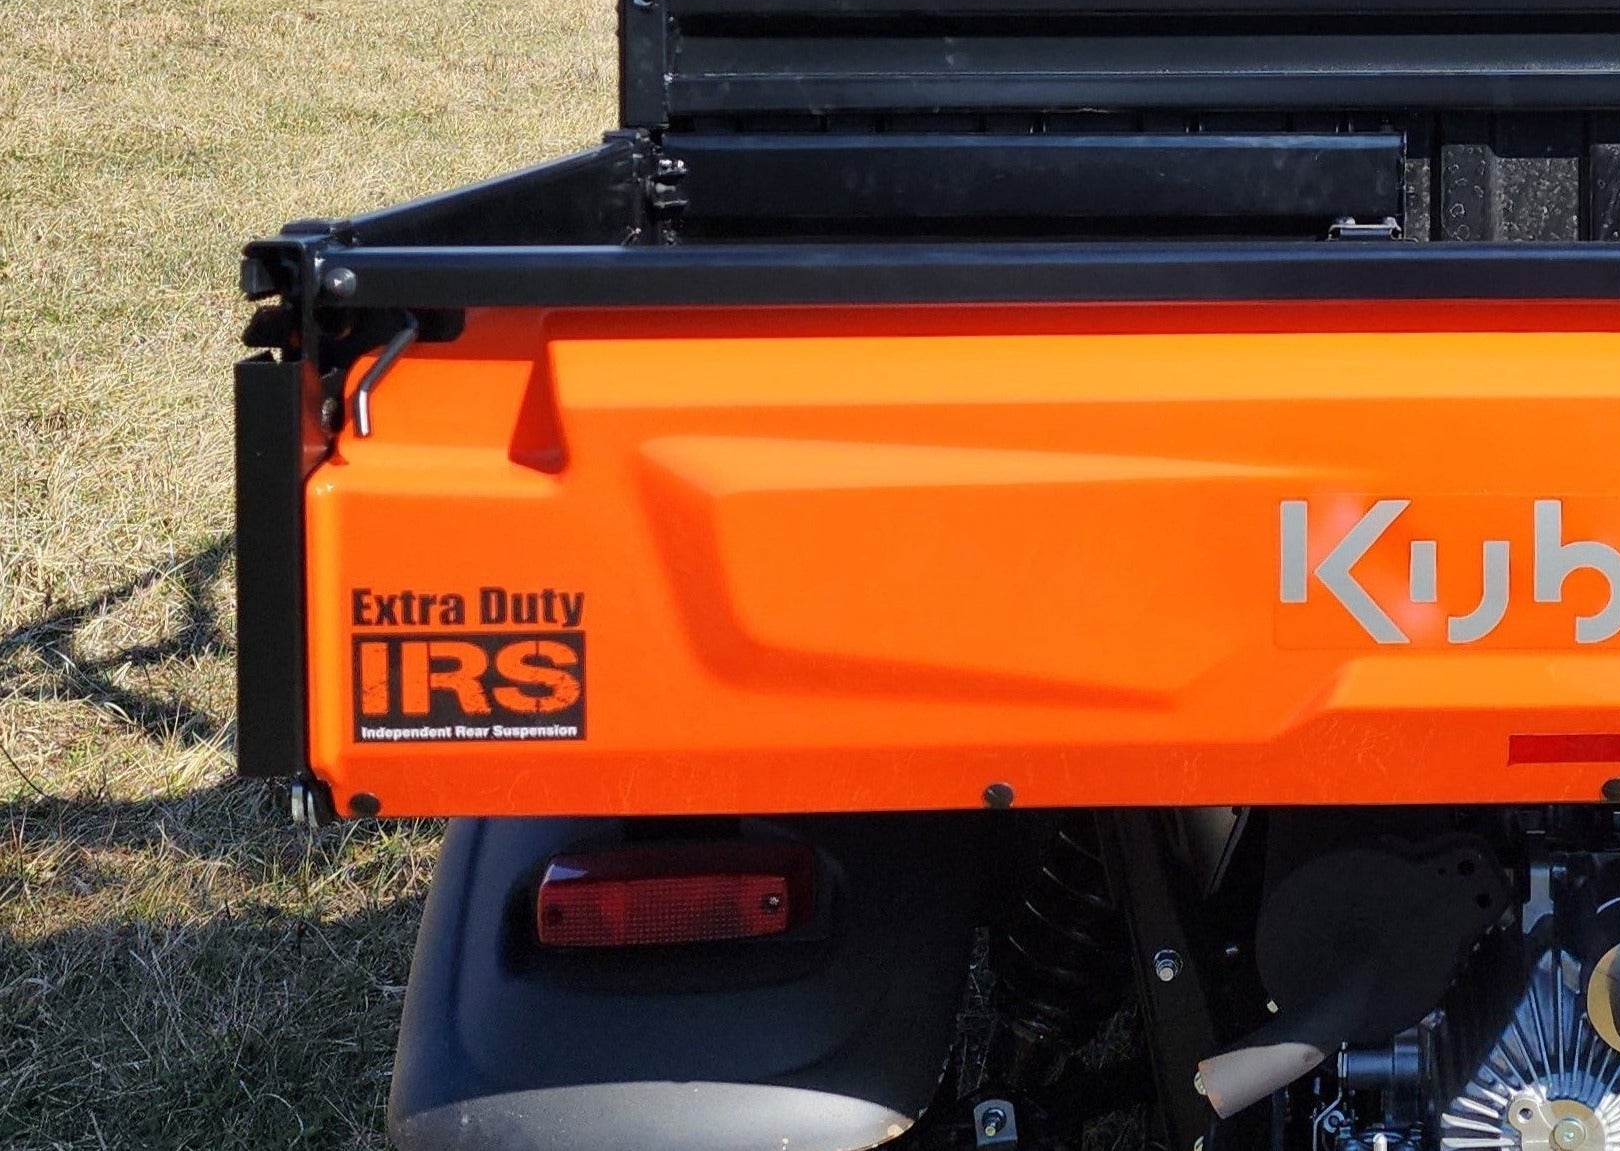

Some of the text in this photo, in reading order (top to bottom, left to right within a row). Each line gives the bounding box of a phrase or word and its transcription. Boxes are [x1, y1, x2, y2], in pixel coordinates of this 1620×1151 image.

[352, 586, 584, 628] Extra Duty
[360, 639, 582, 716] IRS
[361, 724, 578, 741] Independent Rear Suspension
